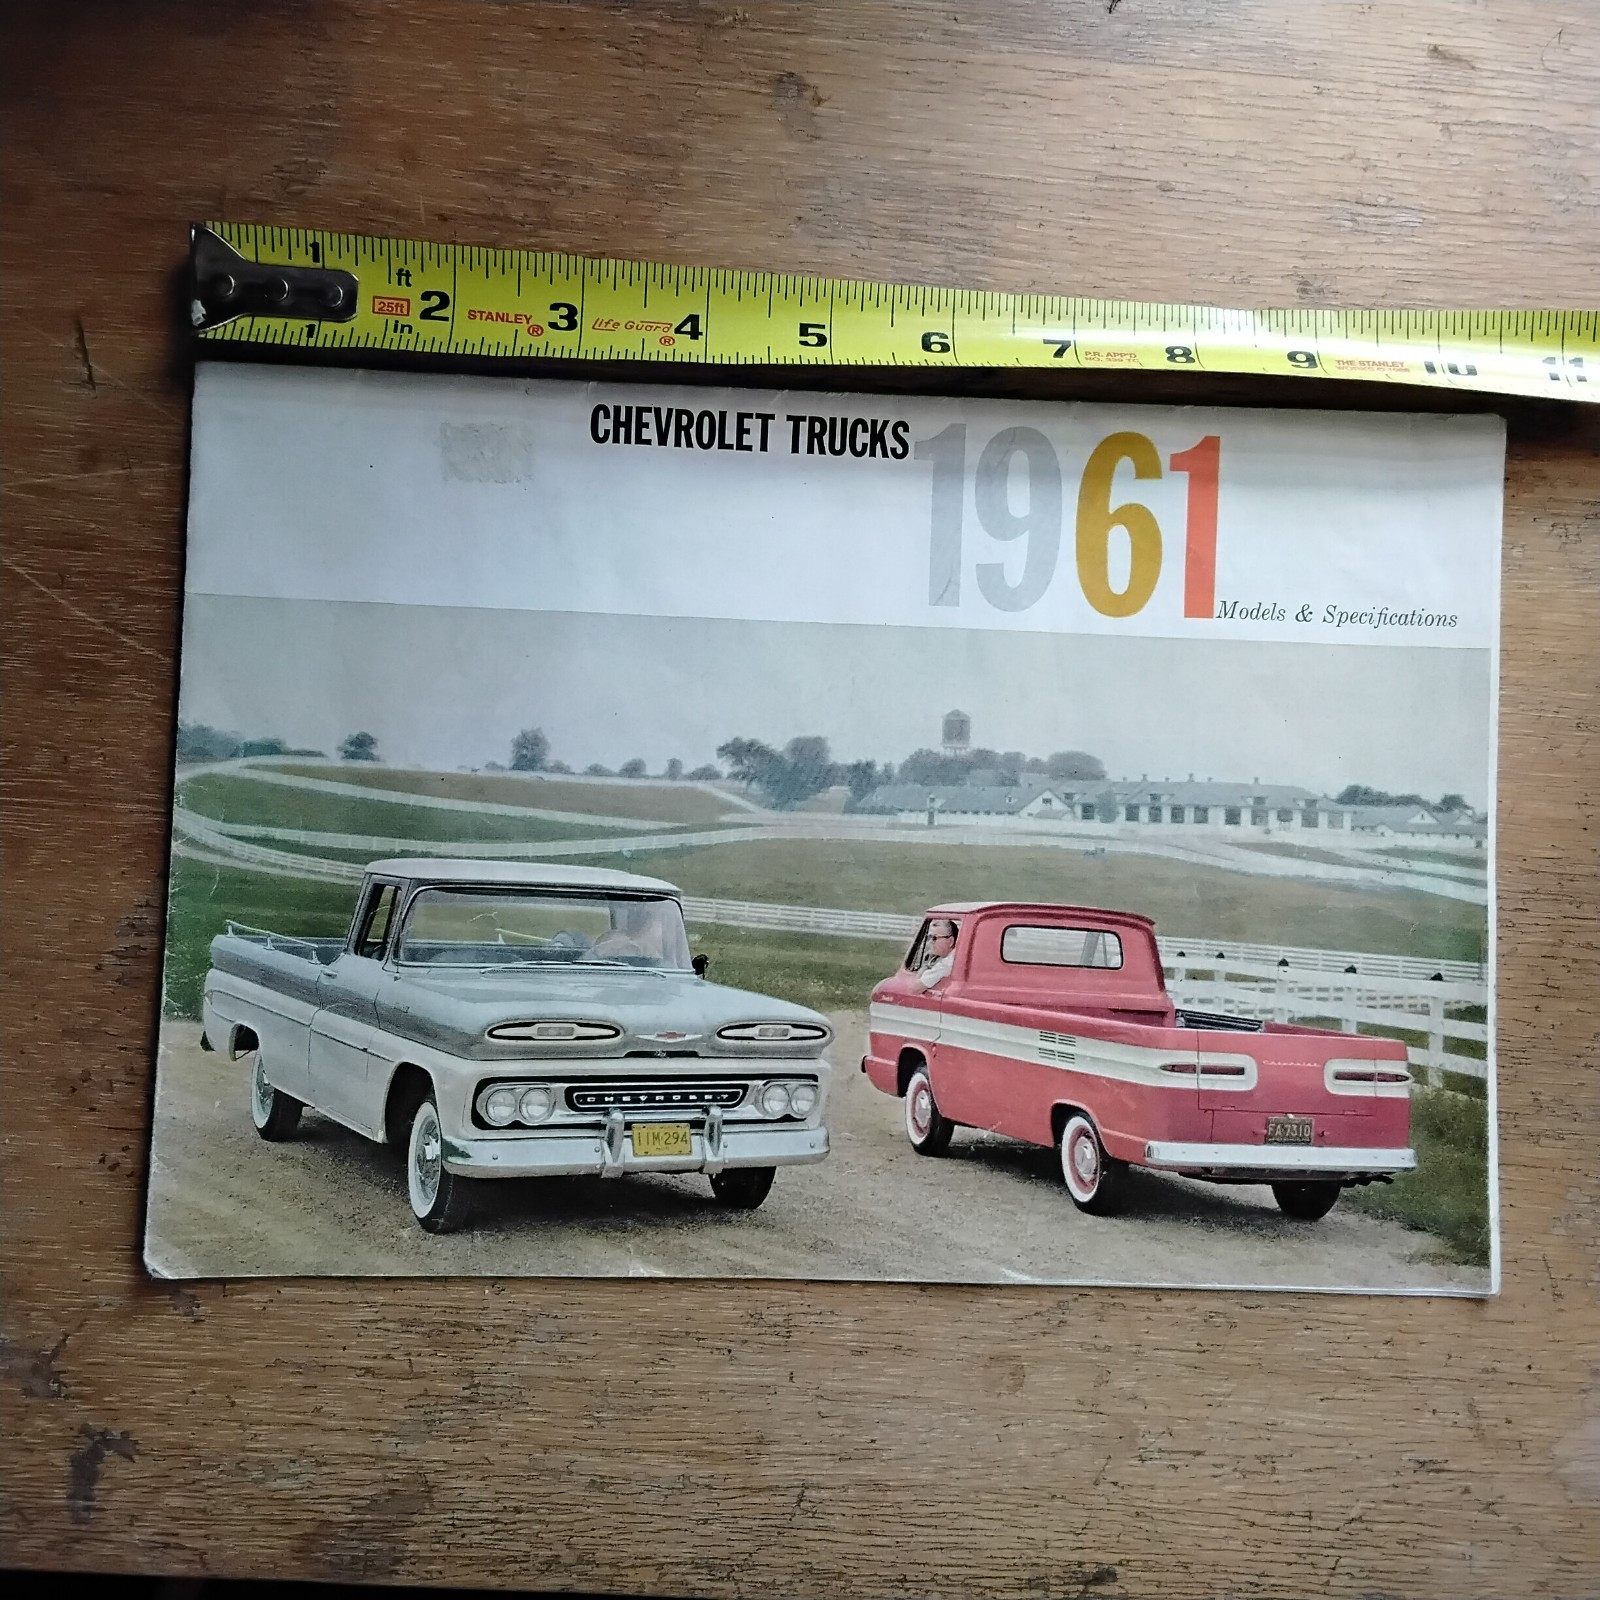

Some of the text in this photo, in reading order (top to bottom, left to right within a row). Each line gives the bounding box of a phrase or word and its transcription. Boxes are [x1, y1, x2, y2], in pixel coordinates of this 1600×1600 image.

[309, 241, 321, 263] 1
[395, 268, 412, 287] ft
[377, 302, 406, 314] 25ft
[467, 309, 533, 325] STANLEY
[305, 323, 316, 338] 1
[393, 320, 413, 334] in
[419, 290, 450, 322] 2
[547, 302, 579, 331] 3
[673, 313, 704, 341] 4
[798, 322, 828, 348] 5
[921, 331, 951, 354] 6
[1042, 338, 1072, 359] 7
[1164, 345, 1196, 364] 8
[1286, 350, 1318, 369] 9
[592, 316, 673, 334] Life Guard
[1358, 360, 1405, 368] STANLEY
[590, 402, 1221, 619] CHEVROLET TRUCKS 1961
[1215, 600, 1459, 629] Models & Specifications
